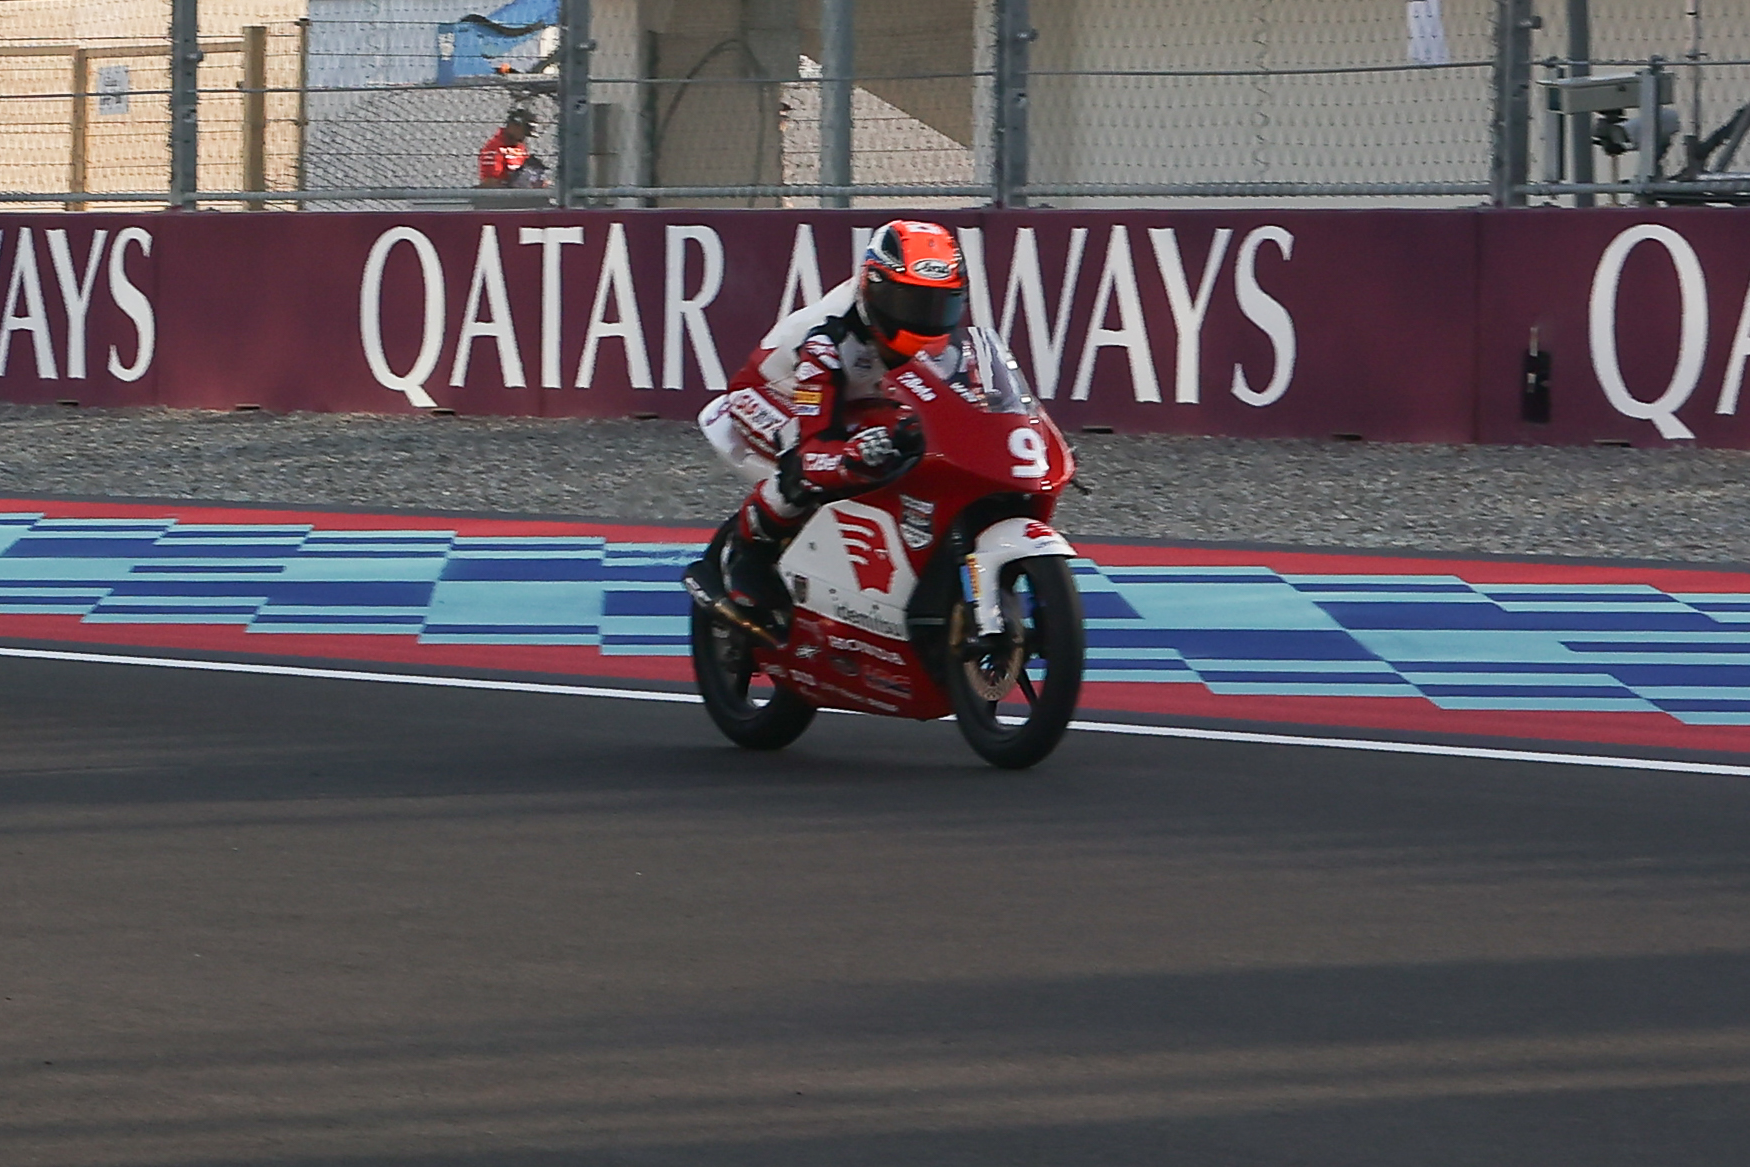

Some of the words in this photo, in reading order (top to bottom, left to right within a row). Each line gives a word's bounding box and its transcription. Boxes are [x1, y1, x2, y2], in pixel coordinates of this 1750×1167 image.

[360, 223, 727, 408] QATAR
[777, 223, 1296, 407] AWAYS
[1008, 427, 1050, 478] 9
